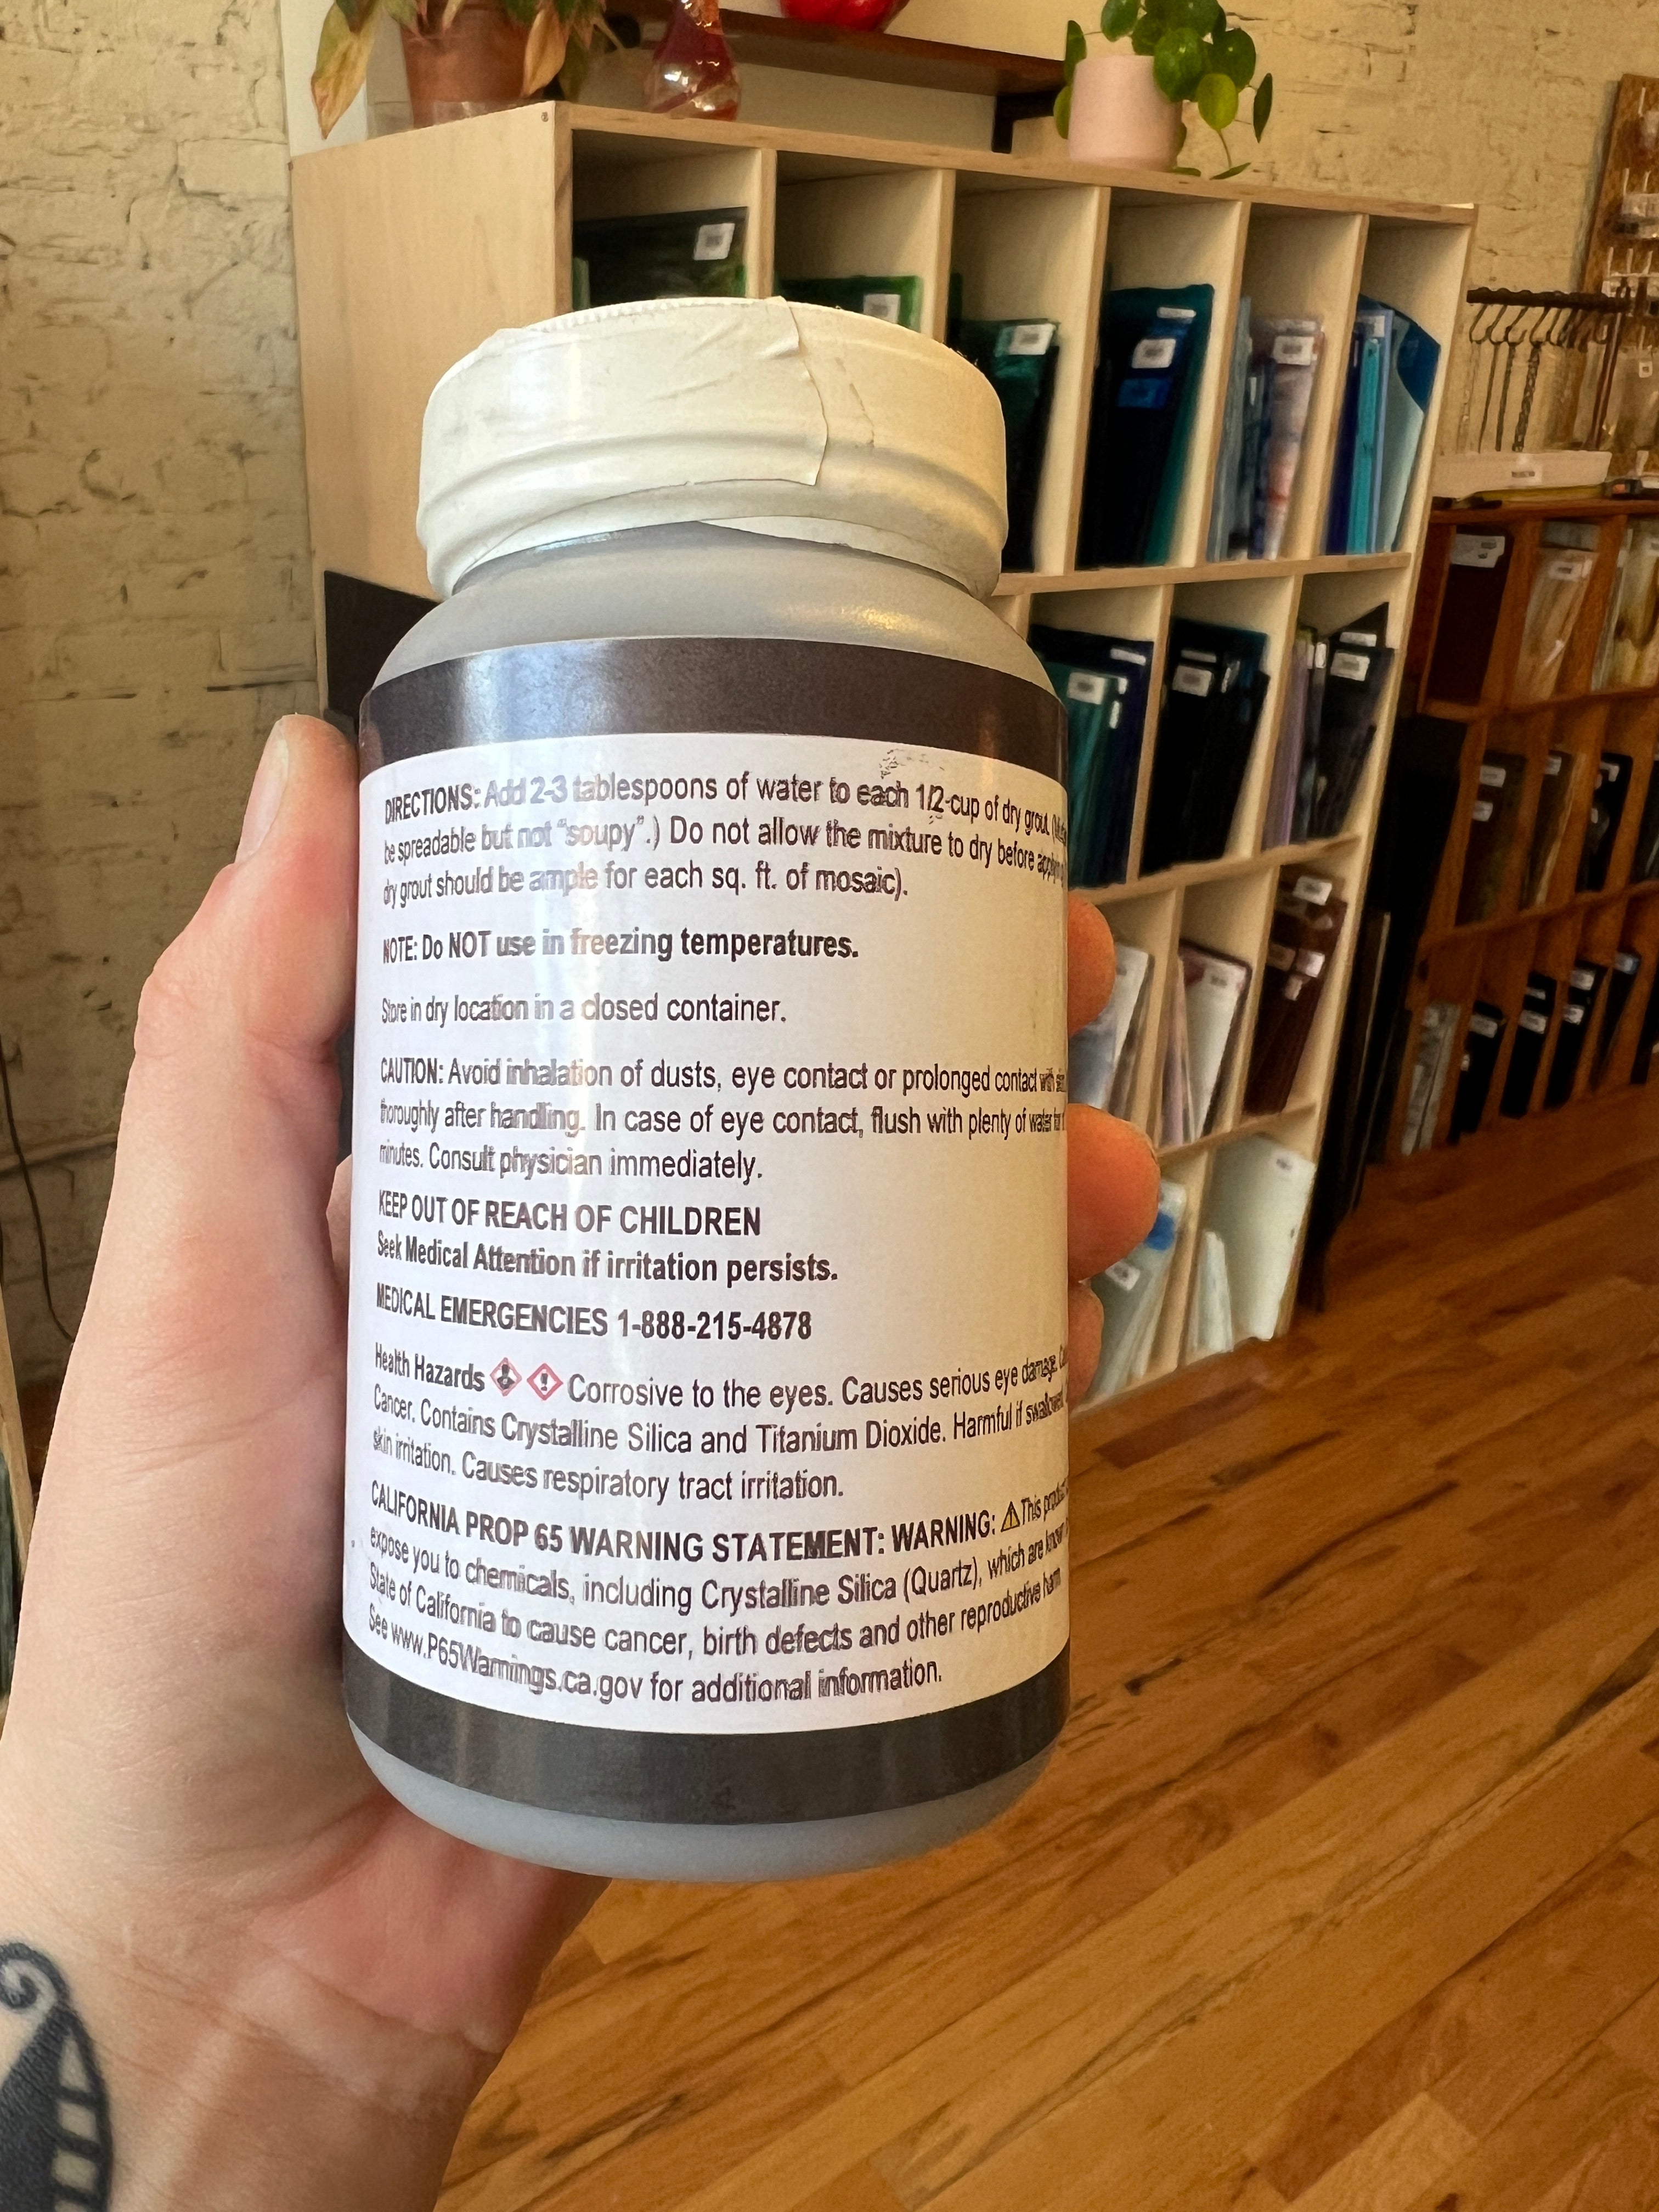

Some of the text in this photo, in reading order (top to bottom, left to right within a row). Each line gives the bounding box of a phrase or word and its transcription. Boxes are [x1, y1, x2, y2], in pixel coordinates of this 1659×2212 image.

[385, 783, 481, 825] DIRECTIONS:
[484, 777, 526, 807] Add
[531, 775, 568, 804] 2-3
[574, 772, 717, 805] tablespoons
[726, 771, 750, 800] of
[757, 775, 822, 802] water
[830, 777, 850, 804] to
[857, 780, 909, 807] each
[985, 795, 998, 821] of
[1002, 798, 1021, 833] dry
[385, 840, 395, 865] be
[398, 827, 476, 866] spreadable
[481, 822, 514, 851] but
[518, 821, 552, 848] not
[670, 815, 703, 845] Do
[713, 817, 749, 845] not
[758, 817, 821, 847] allow
[826, 819, 861, 848] the
[868, 823, 943, 855] mixture
[947, 830, 963, 859] to
[969, 833, 992, 868] dry
[998, 838, 1034, 871] before
[400, 875, 432, 909] grout
[436, 866, 493, 896] should
[498, 866, 524, 892] be
[529, 861, 599, 897] ample
[605, 860, 637, 889] for
[644, 860, 702, 889] each
[712, 866, 746, 897] sq.
[755, 860, 777, 890] ft.
[786, 861, 810, 890] of
[816, 866, 909, 902] mosaic).
[383, 927, 859, 964] NOTE: Do NOT use in freezing temperatures.
[382, 992, 787, 1028] Store in dry location in a closed container.
[381, 1057, 444, 1085] CAUTION:
[448, 1058, 501, 1086] Avoid
[506, 1058, 612, 1087] inhalation
[620, 1059, 644, 1087] of
[651, 1059, 721, 1092] dusts,
[732, 1067, 775, 1095] eye
[783, 1062, 868, 1090] contact
[874, 1068, 897, 1090] or
[902, 1063, 990, 1098] prolonged
[995, 1068, 1037, 1092] contact
[444, 1101, 485, 1128] after
[595, 1103, 616, 1131] In
[624, 1109, 680, 1132] case
[690, 1104, 714, 1133] of
[721, 1110, 764, 1141] eye
[772, 1107, 862, 1138] contact,
[871, 1105, 921, 1134] flush
[927, 1106, 962, 1134] with
[969, 1107, 1011, 1140] plenty
[1015, 1107, 1026, 1133] of
[429, 1142, 495, 1171] Consult
[500, 1146, 602, 1180] physician
[611, 1149, 763, 1186] immediately.
[379, 1189, 761, 1236] KEEP OUT OF REACH OF CHILDREN
[377, 1230, 838, 1288] Seek Medical Attention if irritation persists.
[376, 1282, 812, 1340] MEDICAL EMERGENCIES 1-888-215-4878
[375, 1341, 410, 1378] Health
[414, 1353, 485, 1391] Hazards
[568, 1374, 683, 1407] Corrosive
[693, 1379, 714, 1408] to
[724, 1379, 761, 1408] the
[770, 1383, 833, 1414] eyes.
[842, 1375, 923, 1406] Causes
[930, 1368, 990, 1399] serious
[995, 1367, 1018, 1396] eye
[374, 1383, 415, 1423] Cancer.
[421, 1398, 495, 1437] Contains
[501, 1412, 618, 1449] Crystalline
[628, 1421, 691, 1453] Silica
[702, 1425, 746, 1453] and
[755, 1422, 857, 1453] Titanium
[866, 1418, 946, 1449] Dioxide.
[953, 1402, 1012, 1440] Harmful
[1016, 1400, 1023, 1427] if
[396, 1432, 456, 1475] irritation.
[462, 1450, 538, 1488] Causes
[544, 1466, 669, 1505] respiratory
[679, 1471, 731, 1500] tract
[741, 1470, 843, 1499] irritation.
[371, 1480, 460, 1535] CALIFORNIA
[466, 1510, 529, 1547] PROP
[535, 1523, 562, 1552] 65
[571, 1525, 703, 1562] WARNING
[712, 1527, 885, 1562] STATEMENT:
[891, 1510, 996, 1553] WARNING:
[370, 1526, 408, 1563] expose
[413, 1545, 439, 1573] you
[445, 1550, 459, 1579] to
[466, 1556, 575, 1605] chemicals,
[584, 1573, 691, 1616] including
[702, 1578, 830, 1617] Crystalline
[837, 1571, 896, 1604] Silica
[988, 1542, 1024, 1579] which
[1029, 1539, 1043, 1565] are
[370, 1561, 396, 1600] State
[399, 1580, 412, 1605] of
[416, 1585, 495, 1632] California
[501, 1609, 522, 1638] to
[527, 1621, 596, 1649] cause
[605, 1627, 693, 1660] cancer,
[703, 1626, 757, 1656] birth
[766, 1622, 853, 1655] defects
[859, 1614, 899, 1647] and
[906, 1609, 955, 1643] other
[961, 1581, 1041, 1633] reproductive
[369, 1602, 387, 1639] See
[652, 1671, 684, 1702] for
[692, 1669, 811, 1702] additional
[819, 1657, 942, 1698] information.
